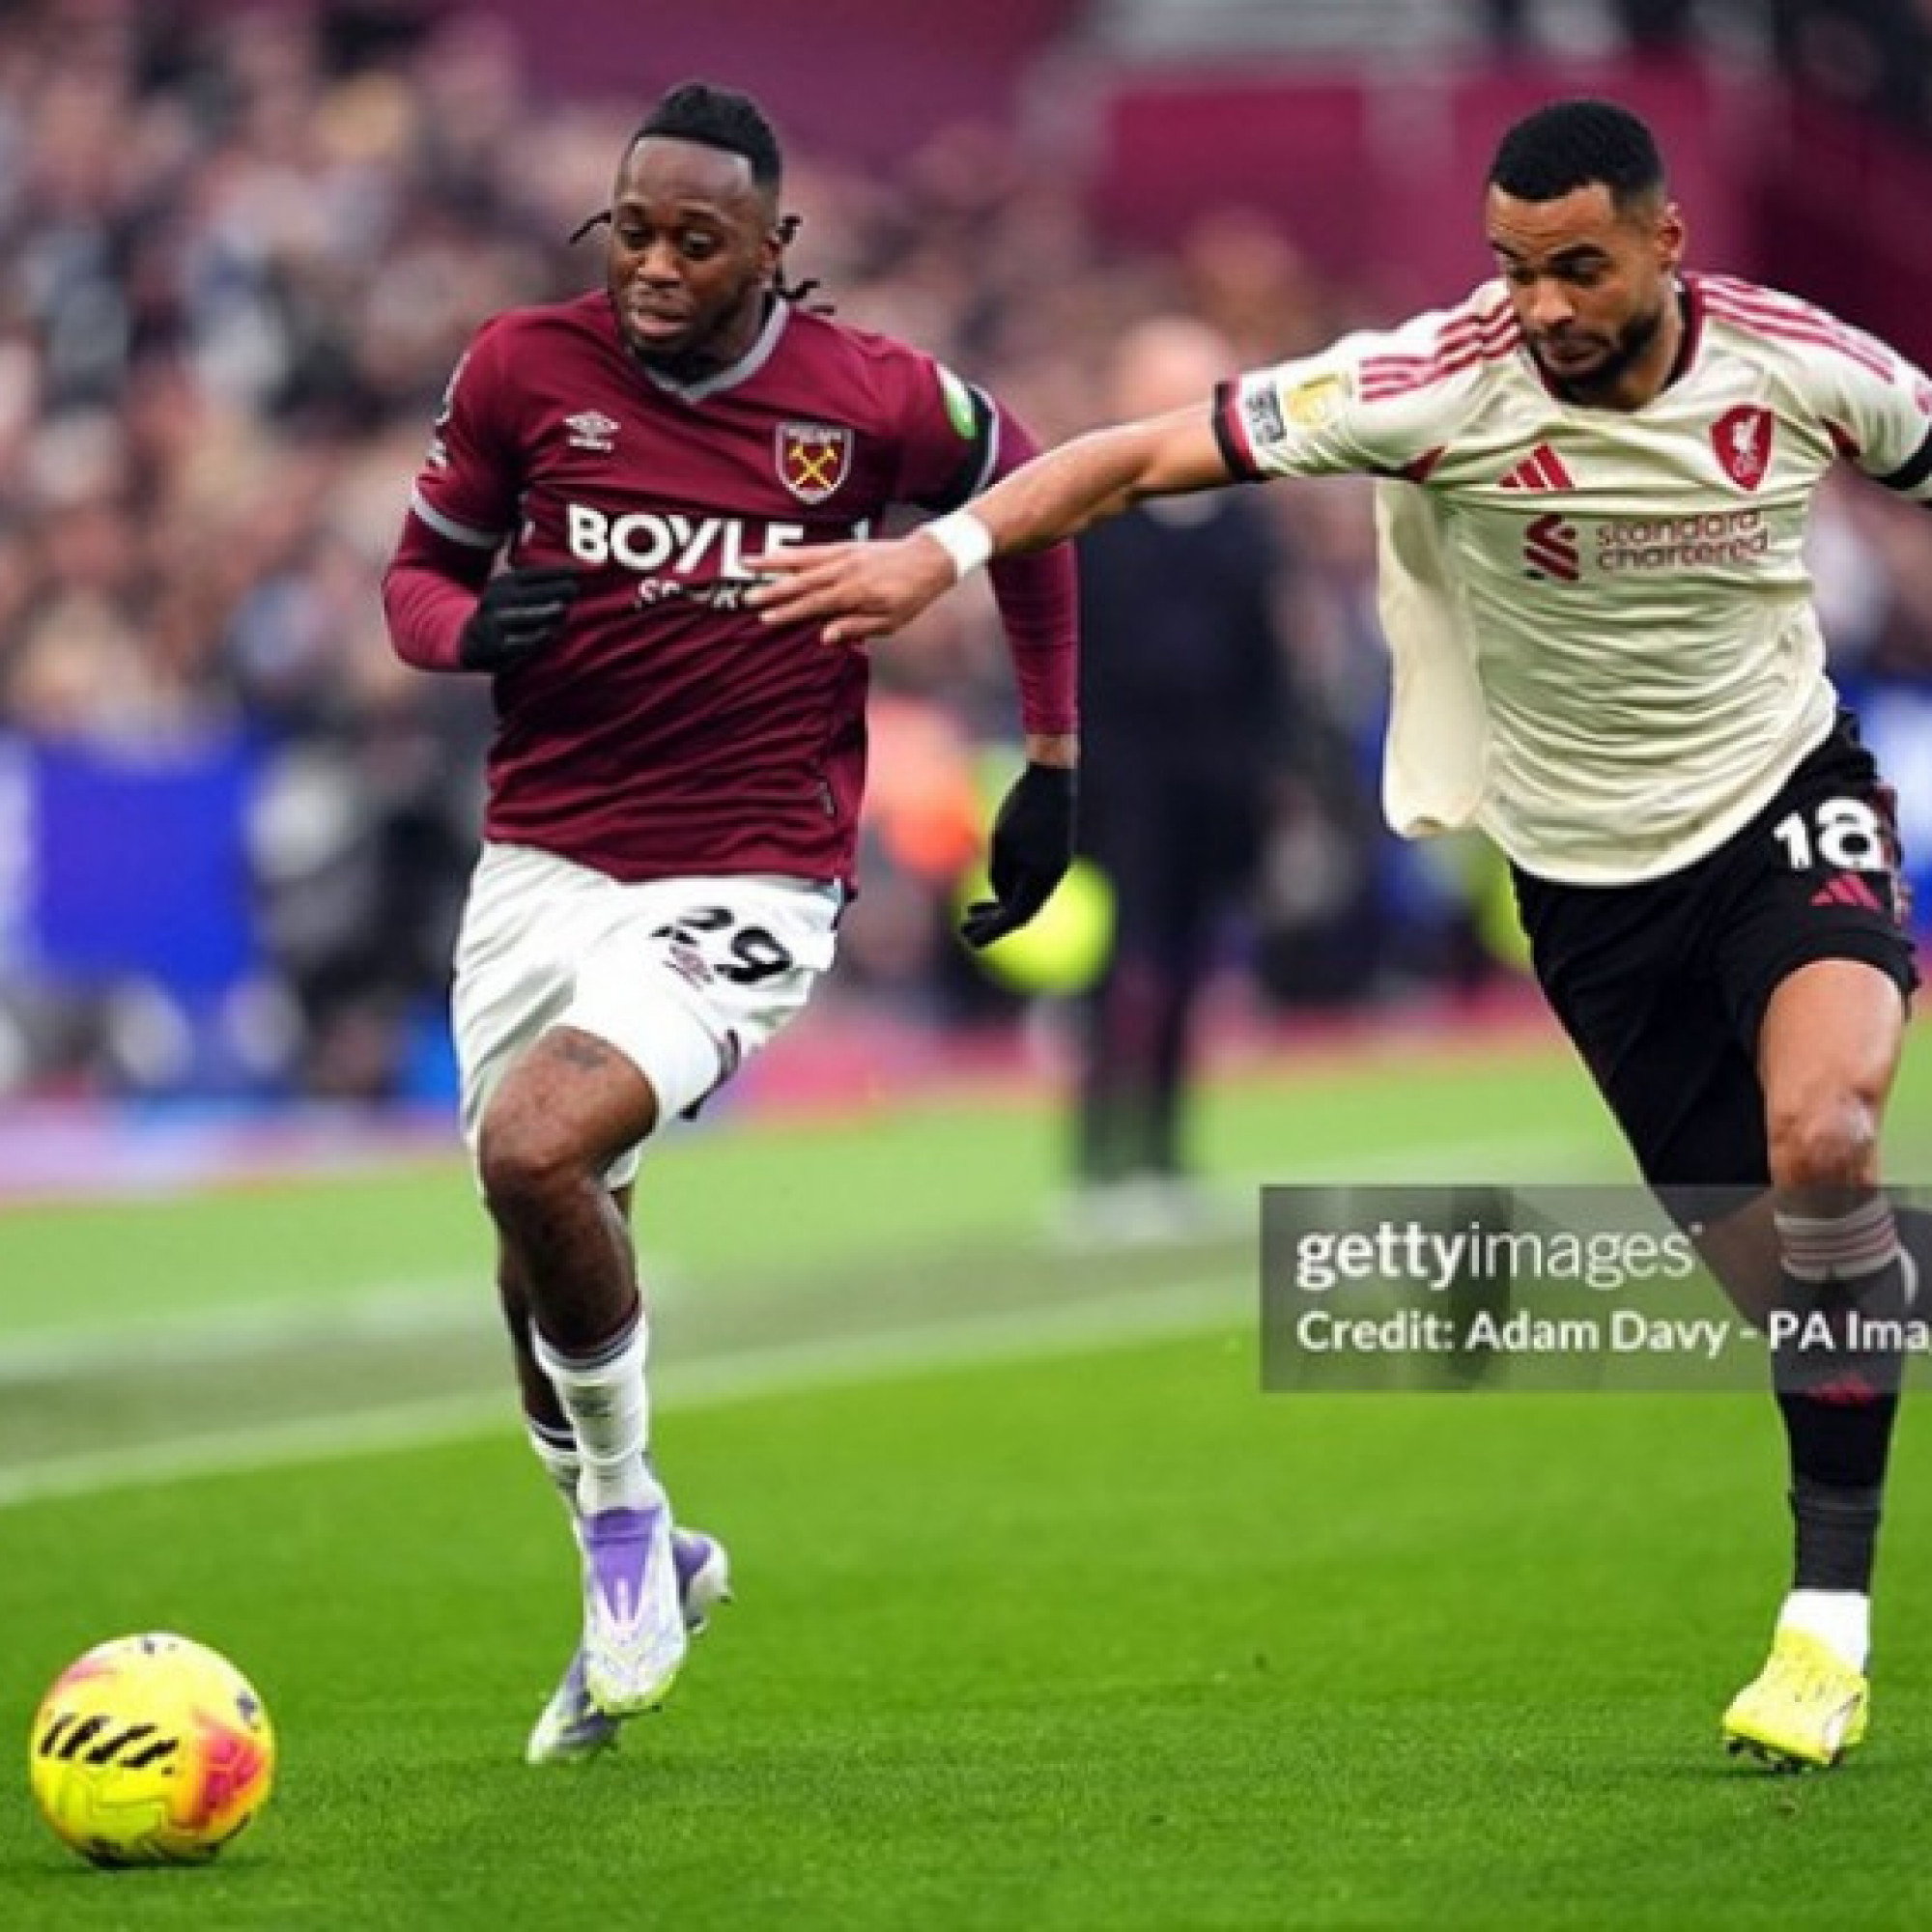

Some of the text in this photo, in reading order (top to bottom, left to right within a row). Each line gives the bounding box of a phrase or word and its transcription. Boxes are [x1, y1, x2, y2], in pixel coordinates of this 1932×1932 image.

[1596, 508, 1761, 547] standard
[1596, 528, 1770, 572] chartered
[1774, 796, 1883, 871] 18
[648, 905, 793, 985] 29
